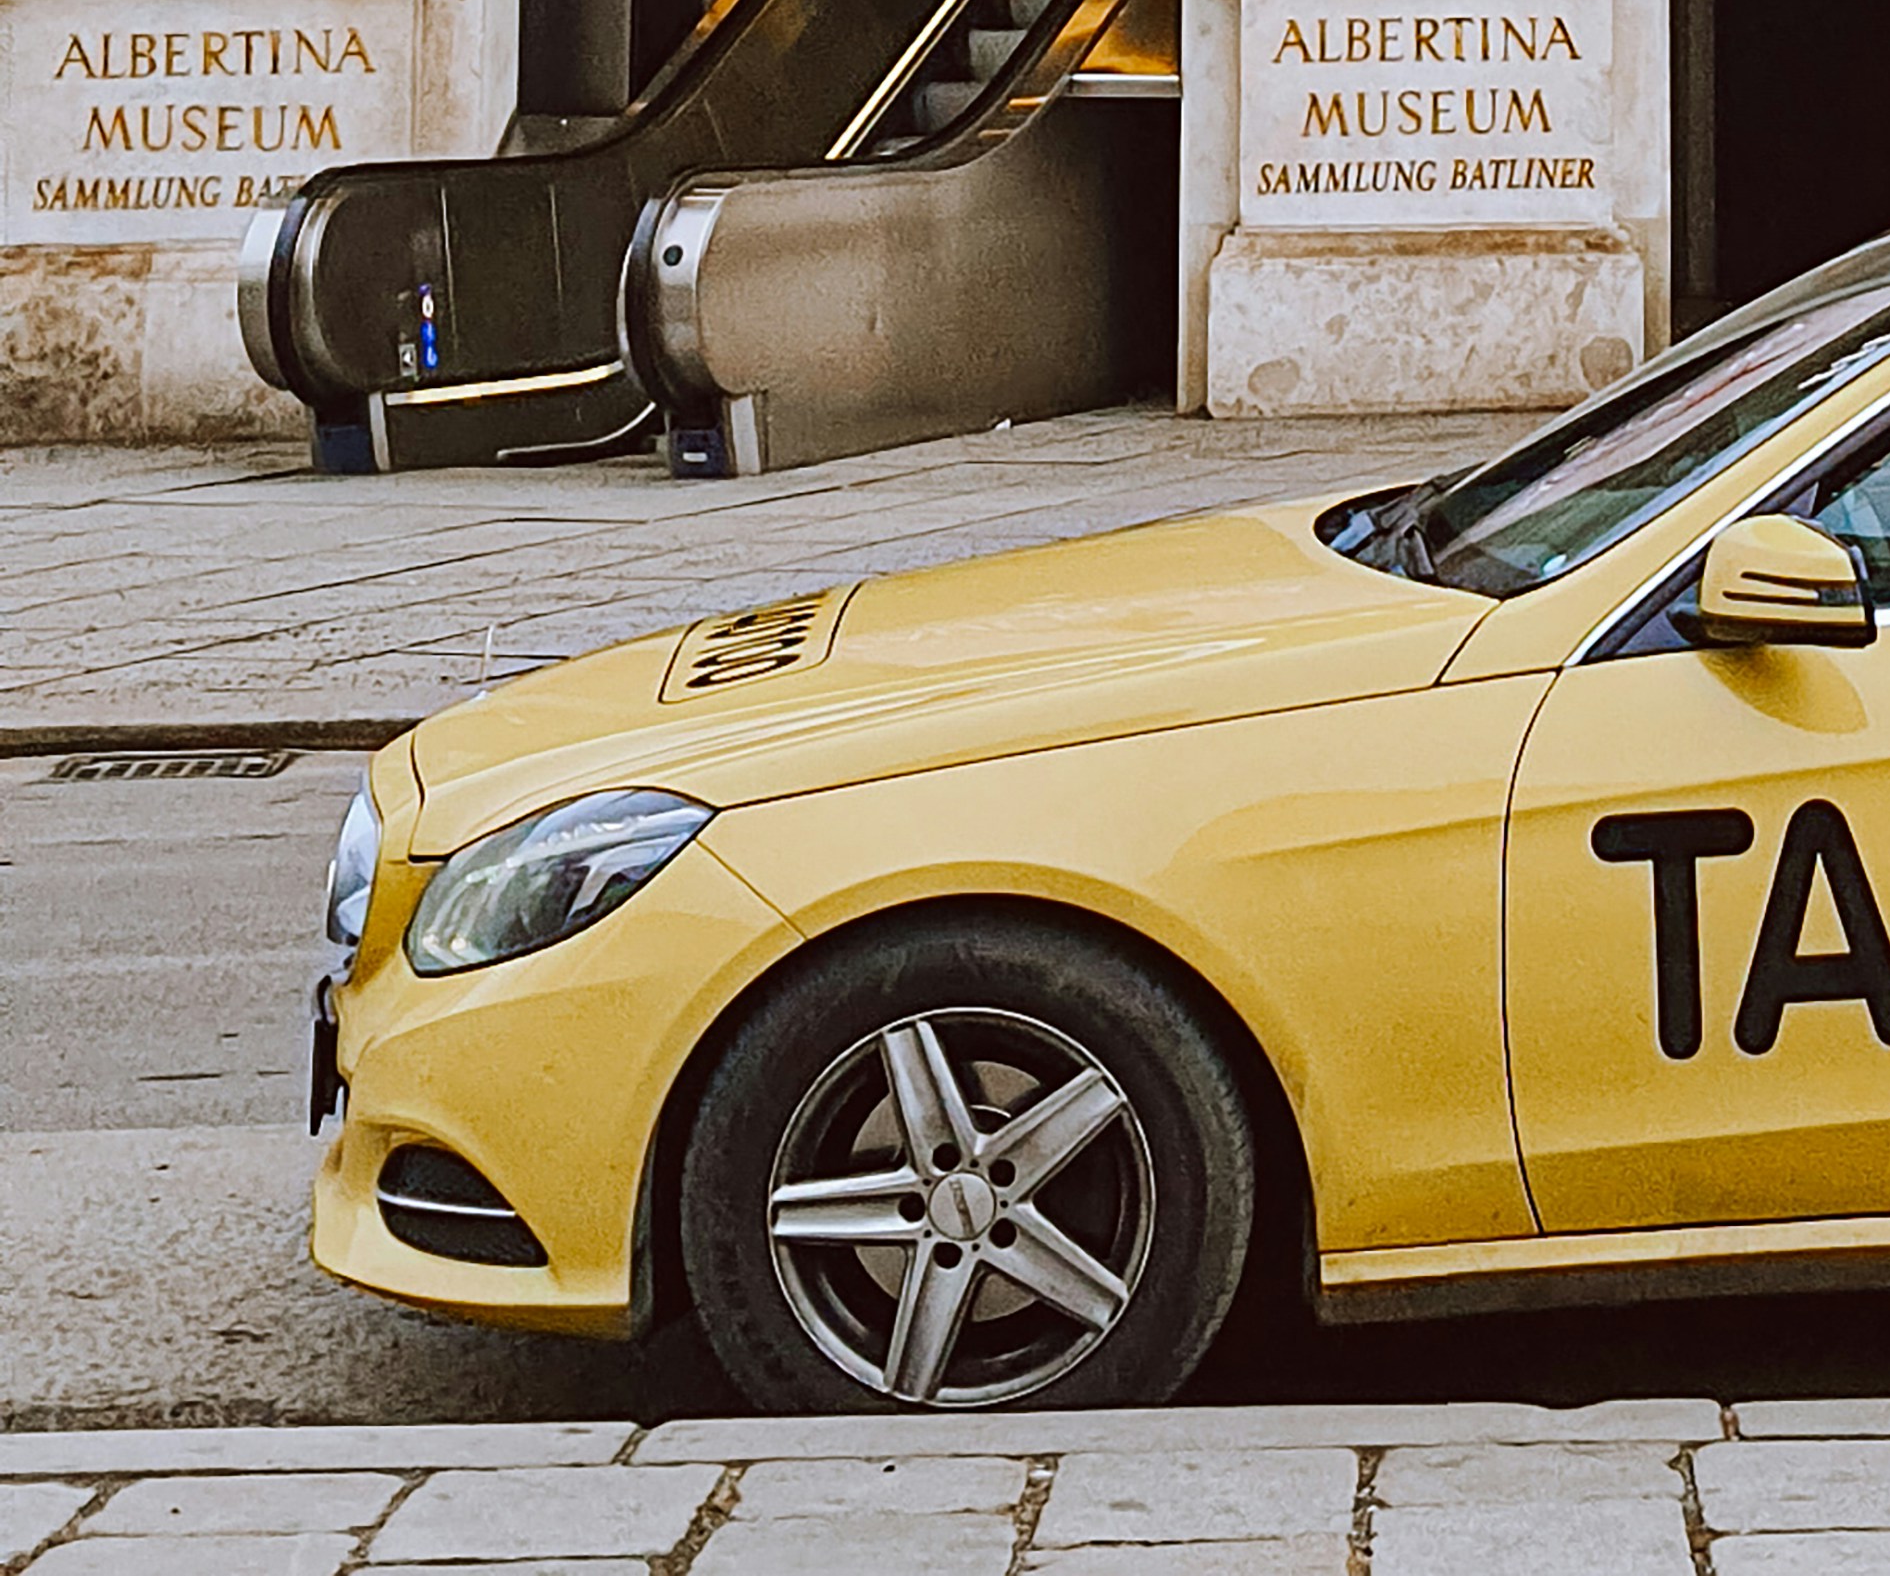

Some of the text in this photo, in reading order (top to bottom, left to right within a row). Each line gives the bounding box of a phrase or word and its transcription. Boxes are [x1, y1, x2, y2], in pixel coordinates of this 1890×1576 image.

[54, 27, 378, 81] ALBERTINA
[1271, 15, 1583, 65] ALBERTINA
[81, 104, 343, 153] MUSEUM
[1300, 88, 1553, 138] MUSEUM
[32, 173, 223, 212] SAMMLUNG
[1256, 157, 1597, 196] SAMMLUNG BATLINER
